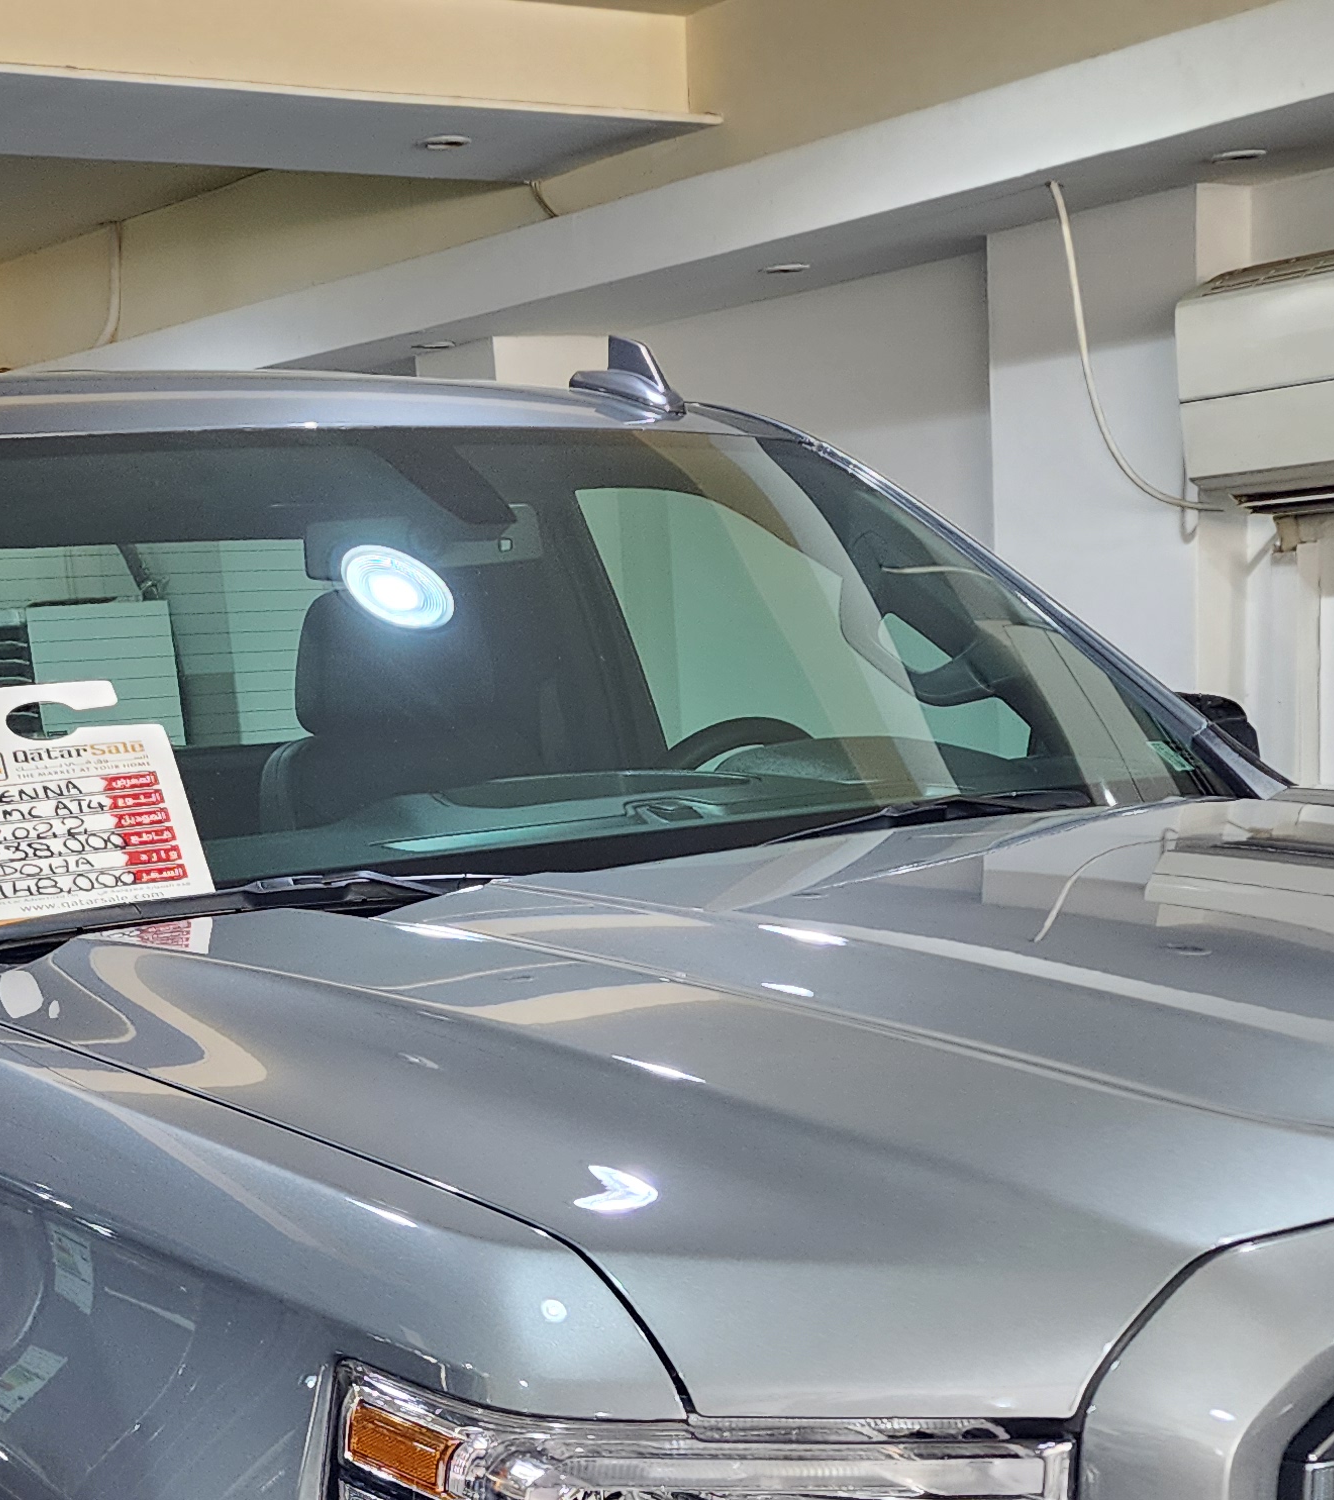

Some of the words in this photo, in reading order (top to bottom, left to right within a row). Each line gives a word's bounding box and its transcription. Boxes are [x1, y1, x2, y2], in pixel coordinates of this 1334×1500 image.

[12, 740, 146, 765] QatarSale
[17, 772, 35, 780] THE
[54, 798, 108, 817] AT4
[19, 891, 166, 912] www.qatarsale.com
